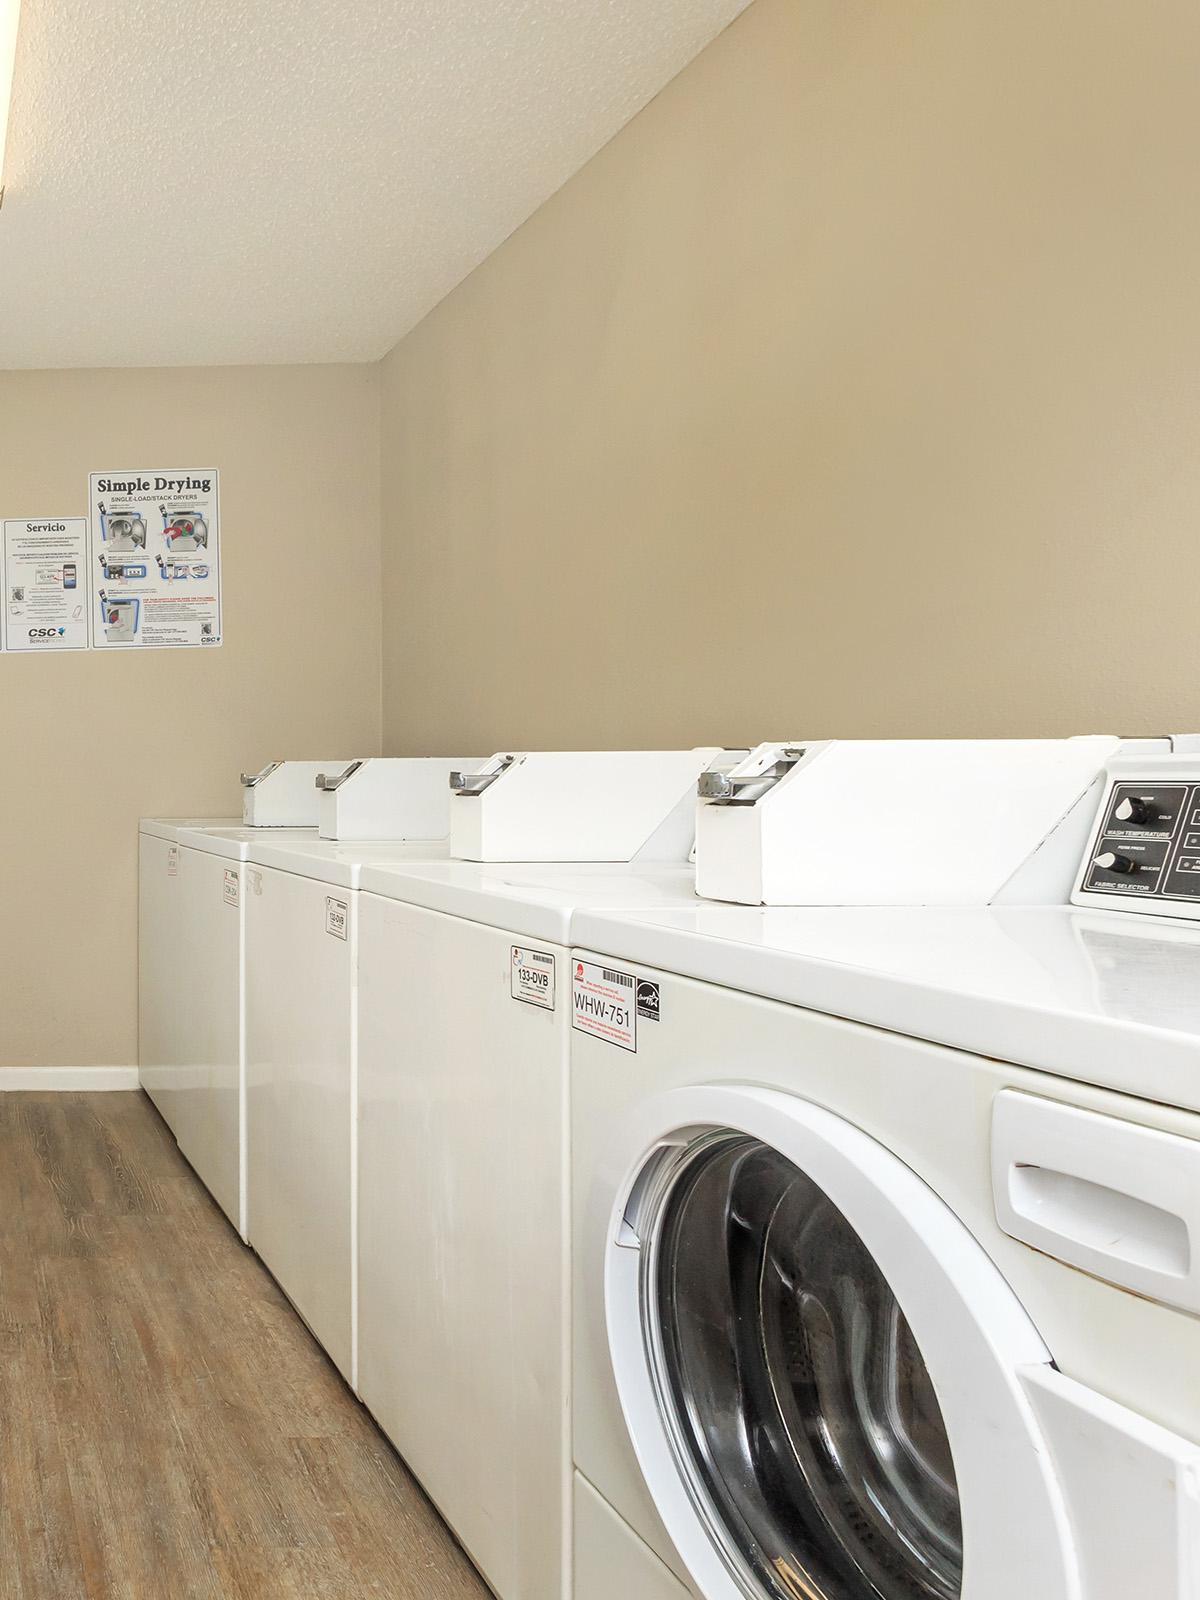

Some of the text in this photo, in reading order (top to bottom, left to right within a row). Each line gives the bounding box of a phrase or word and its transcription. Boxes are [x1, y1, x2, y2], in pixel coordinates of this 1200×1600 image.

[97, 477, 211, 495] Simple Drying
[26, 523, 66, 532] Servicio
[28, 628, 57, 637] CSC
[1117, 883, 1150, 891] SELECTOR
[518, 968, 548, 986] 133-DVB
[574, 992, 629, 1027] WHW-751
